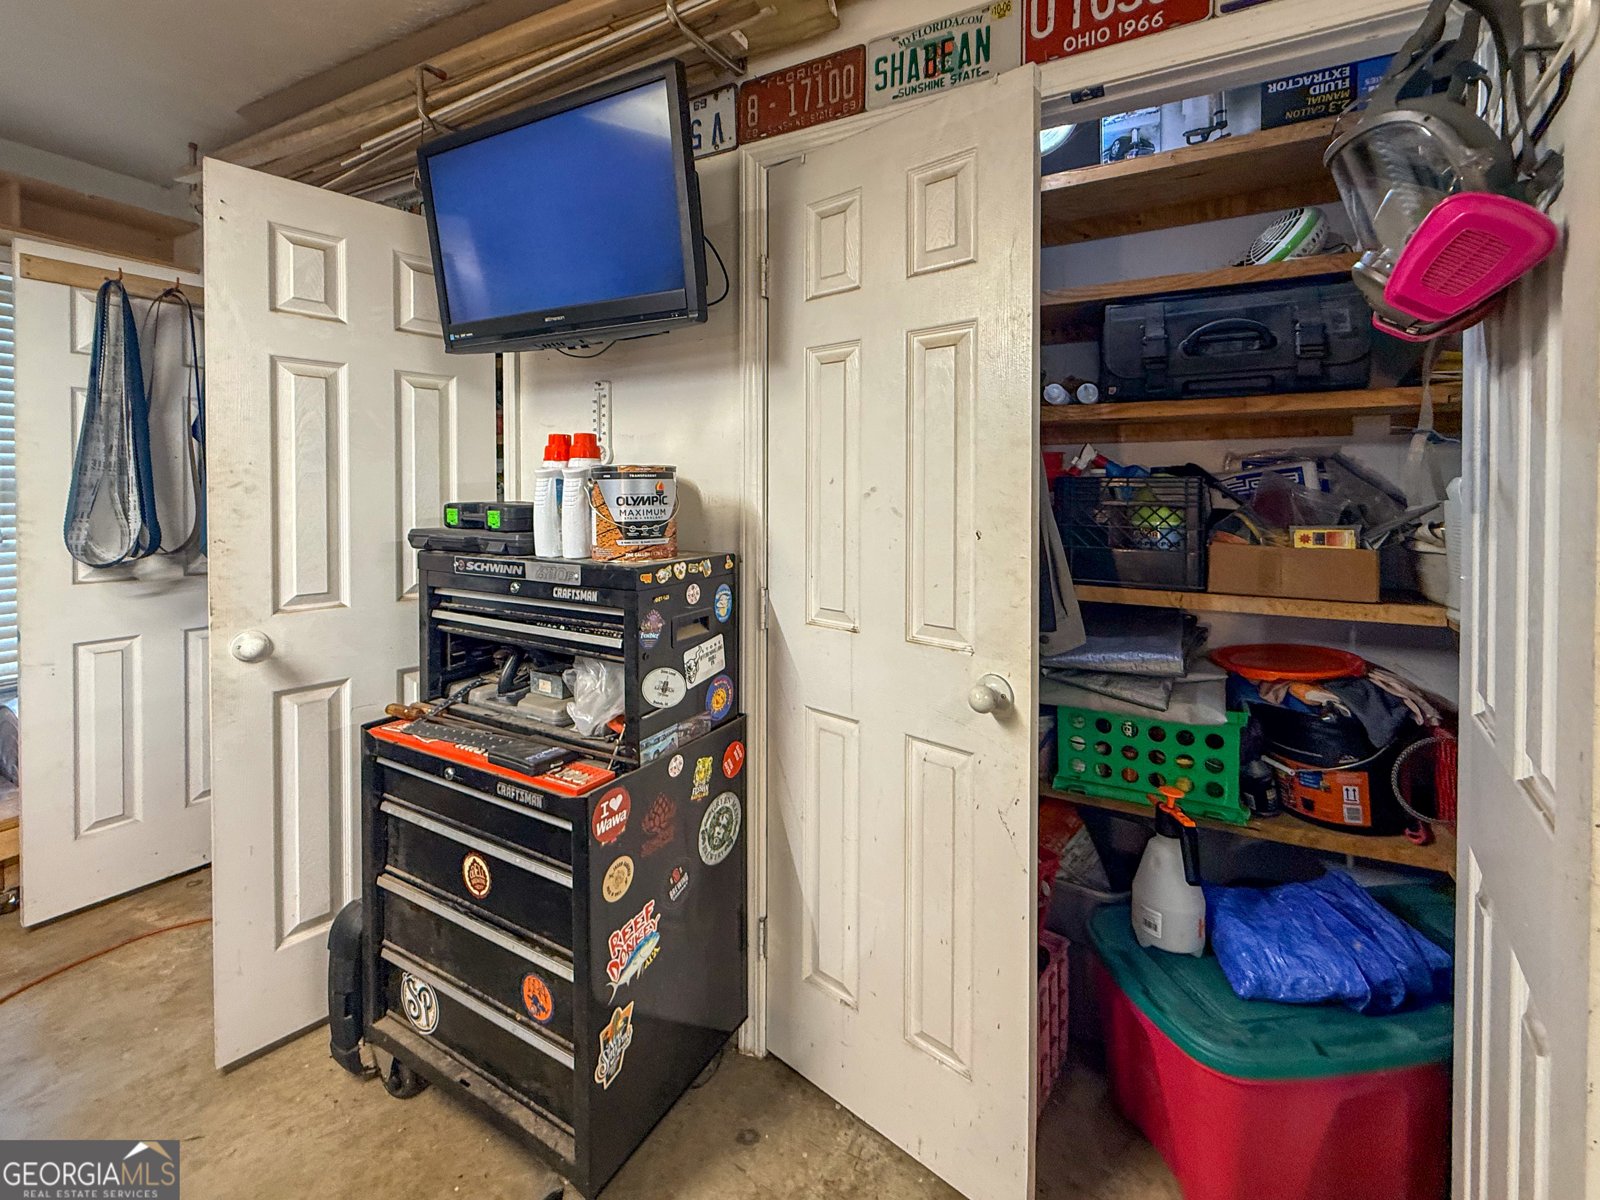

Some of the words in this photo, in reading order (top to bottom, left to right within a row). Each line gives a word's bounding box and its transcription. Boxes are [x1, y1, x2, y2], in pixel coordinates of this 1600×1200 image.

[898, 14, 984, 49] MYFLORIDA.COM
[1063, 26, 1110, 52] OHIO
[1118, 10, 1164, 37] 1966
[874, 25, 991, 92] SHABEAN
[767, 59, 834, 89] FLORIDA
[898, 77, 946, 98] SUNSHINE
[950, 66, 982, 85] STATE
[1267, 66, 1350, 94] EXTRACTOR
[1306, 90, 1350, 105] MANUAL
[1309, 78, 1350, 95] FLUID
[693, 98, 708, 112] 69
[809, 108, 833, 123] STATE
[842, 101, 857, 112] 69
[1284, 104, 1326, 119] GALLON
[1328, 99, 1350, 113] 2.3
[616, 495, 668, 507] OLYMPIC
[619, 508, 667, 517] MAXIMUM
[466, 562, 523, 575] SCHWINN
[553, 587, 598, 603] CRAFTSMAN
[496, 783, 543, 809] CRAFTSMAN
[600, 801, 609, 819] I
[596, 809, 627, 837] Wawa
[609, 899, 655, 960] REEF
[606, 913, 661, 983] DONKEY
